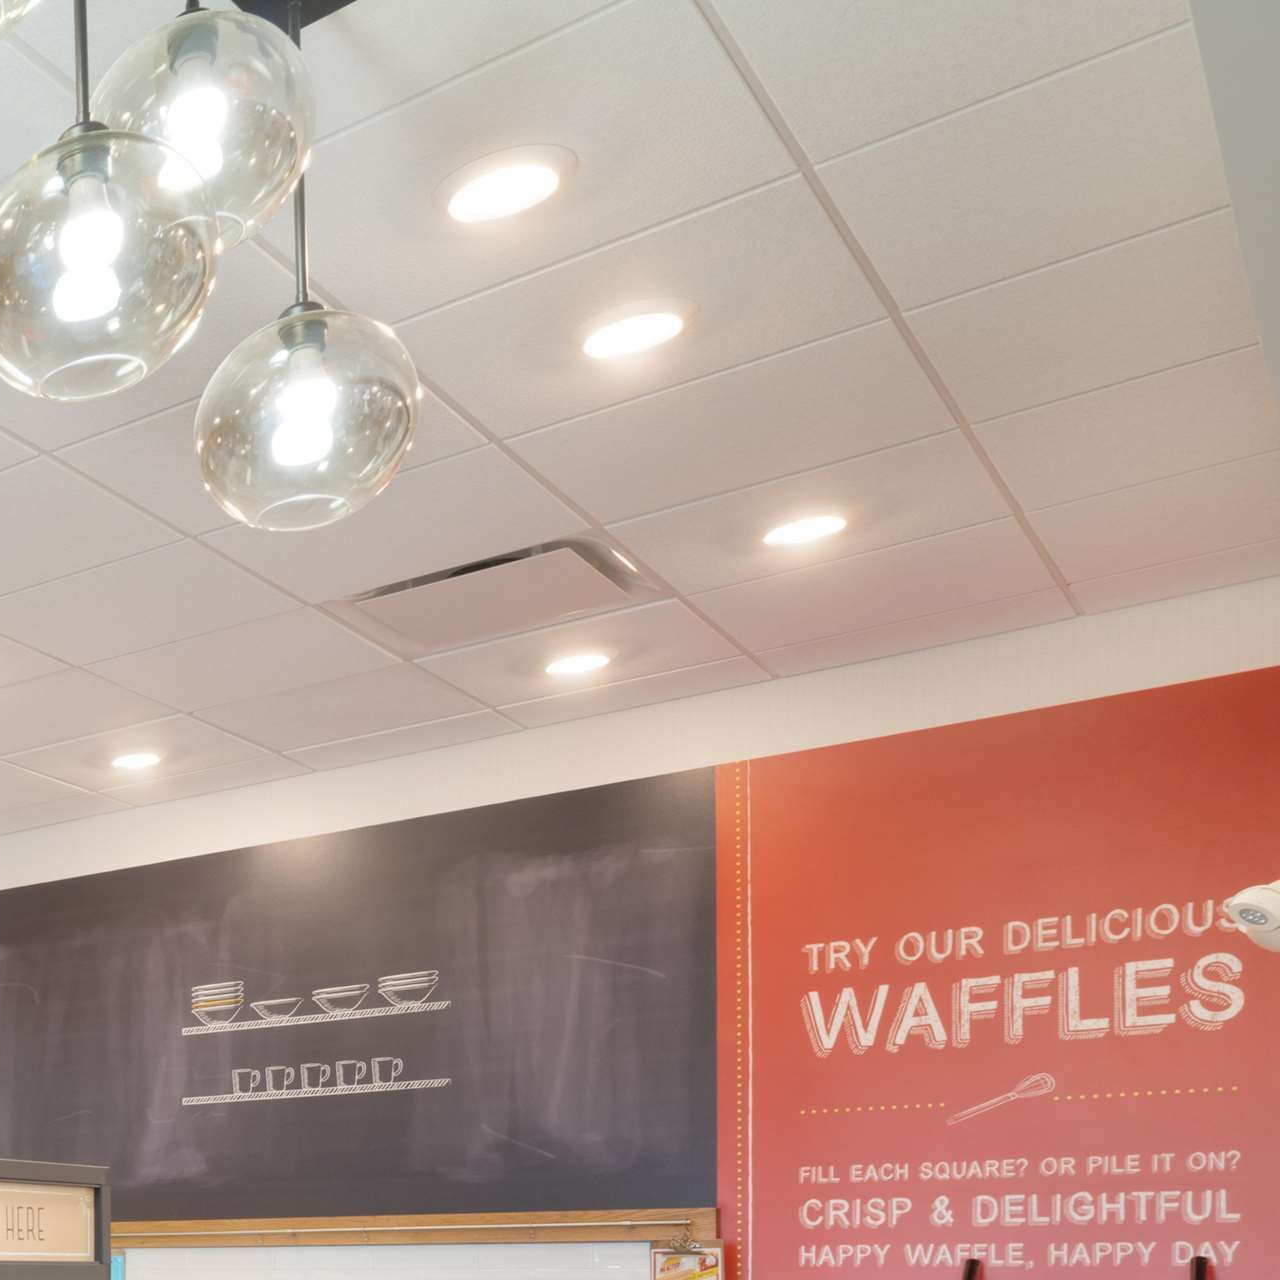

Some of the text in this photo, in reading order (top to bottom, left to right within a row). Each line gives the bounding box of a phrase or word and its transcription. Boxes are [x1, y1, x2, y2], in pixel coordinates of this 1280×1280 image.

[802, 937, 878, 974] TRY
[895, 926, 985, 965] OUR
[800, 952, 1246, 1058] WAFFLES
[799, 1150, 1241, 1184] FILL EACH SQUARE? OR PILE IT ON?
[6, 1205, 46, 1241] HERE
[799, 1189, 1241, 1229] CRISP & DELIGHTFUL
[799, 1240, 1241, 1269] HAPPY WAFFLE, HAPPY DAY
